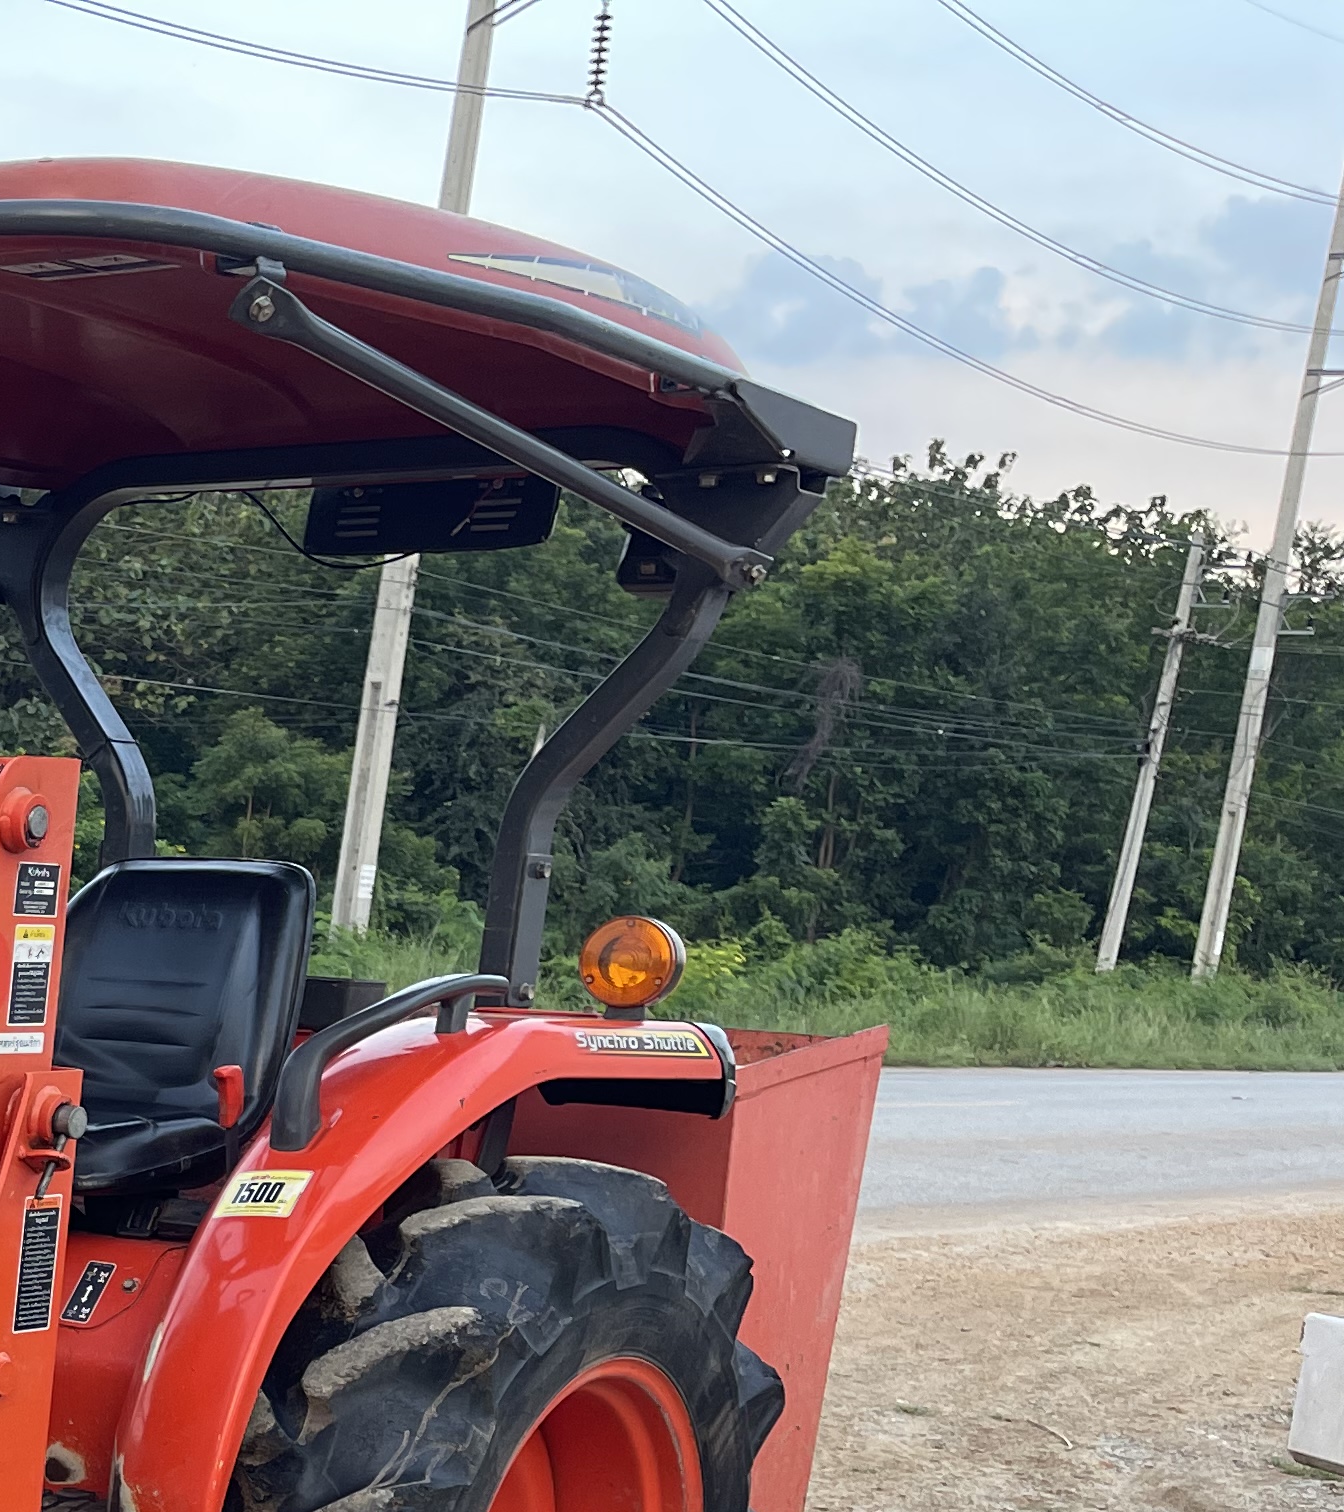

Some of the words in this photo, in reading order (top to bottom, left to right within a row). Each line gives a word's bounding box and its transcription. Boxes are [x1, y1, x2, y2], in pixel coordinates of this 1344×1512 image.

[575, 1031, 639, 1052] Synchro
[642, 1034, 696, 1051] Shuttle
[232, 1182, 286, 1204] 1500
